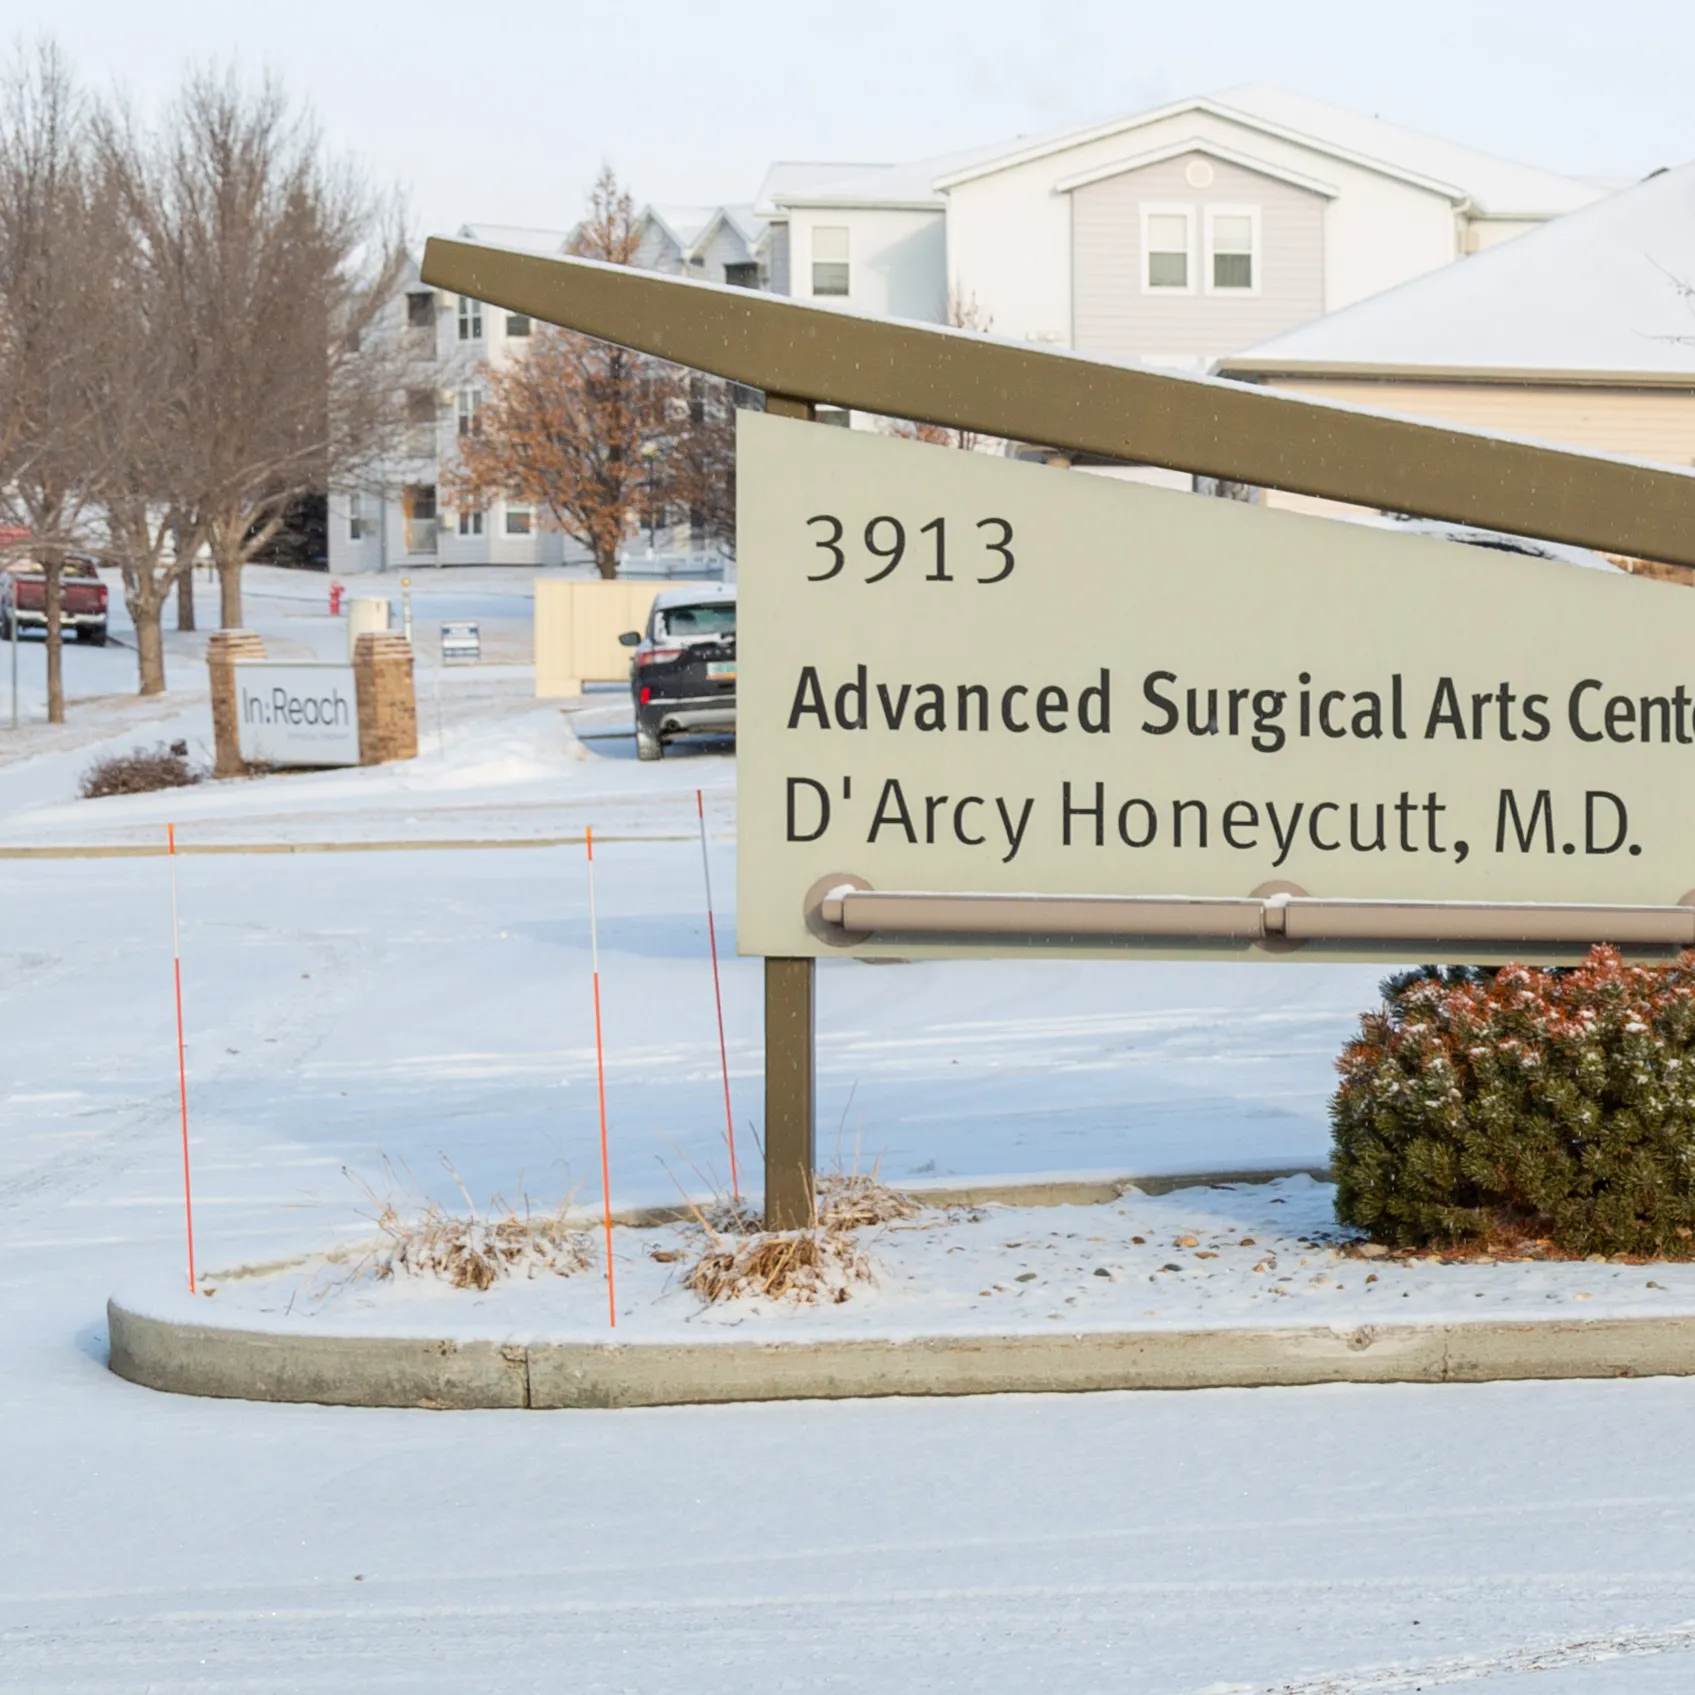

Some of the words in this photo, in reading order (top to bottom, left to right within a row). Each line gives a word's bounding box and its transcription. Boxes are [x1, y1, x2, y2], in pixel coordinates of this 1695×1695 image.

[805, 513, 1016, 585] 3913
[242, 687, 349, 726] In:Reach
[786, 663, 1112, 735] Advanced
[1140, 668, 1408, 754] Surgical
[1423, 675, 1552, 744] Arts
[785, 775, 1036, 865] D'Arcy
[1061, 779, 1470, 869] Honeycutt,
[1494, 787, 1643, 857] M.D.
